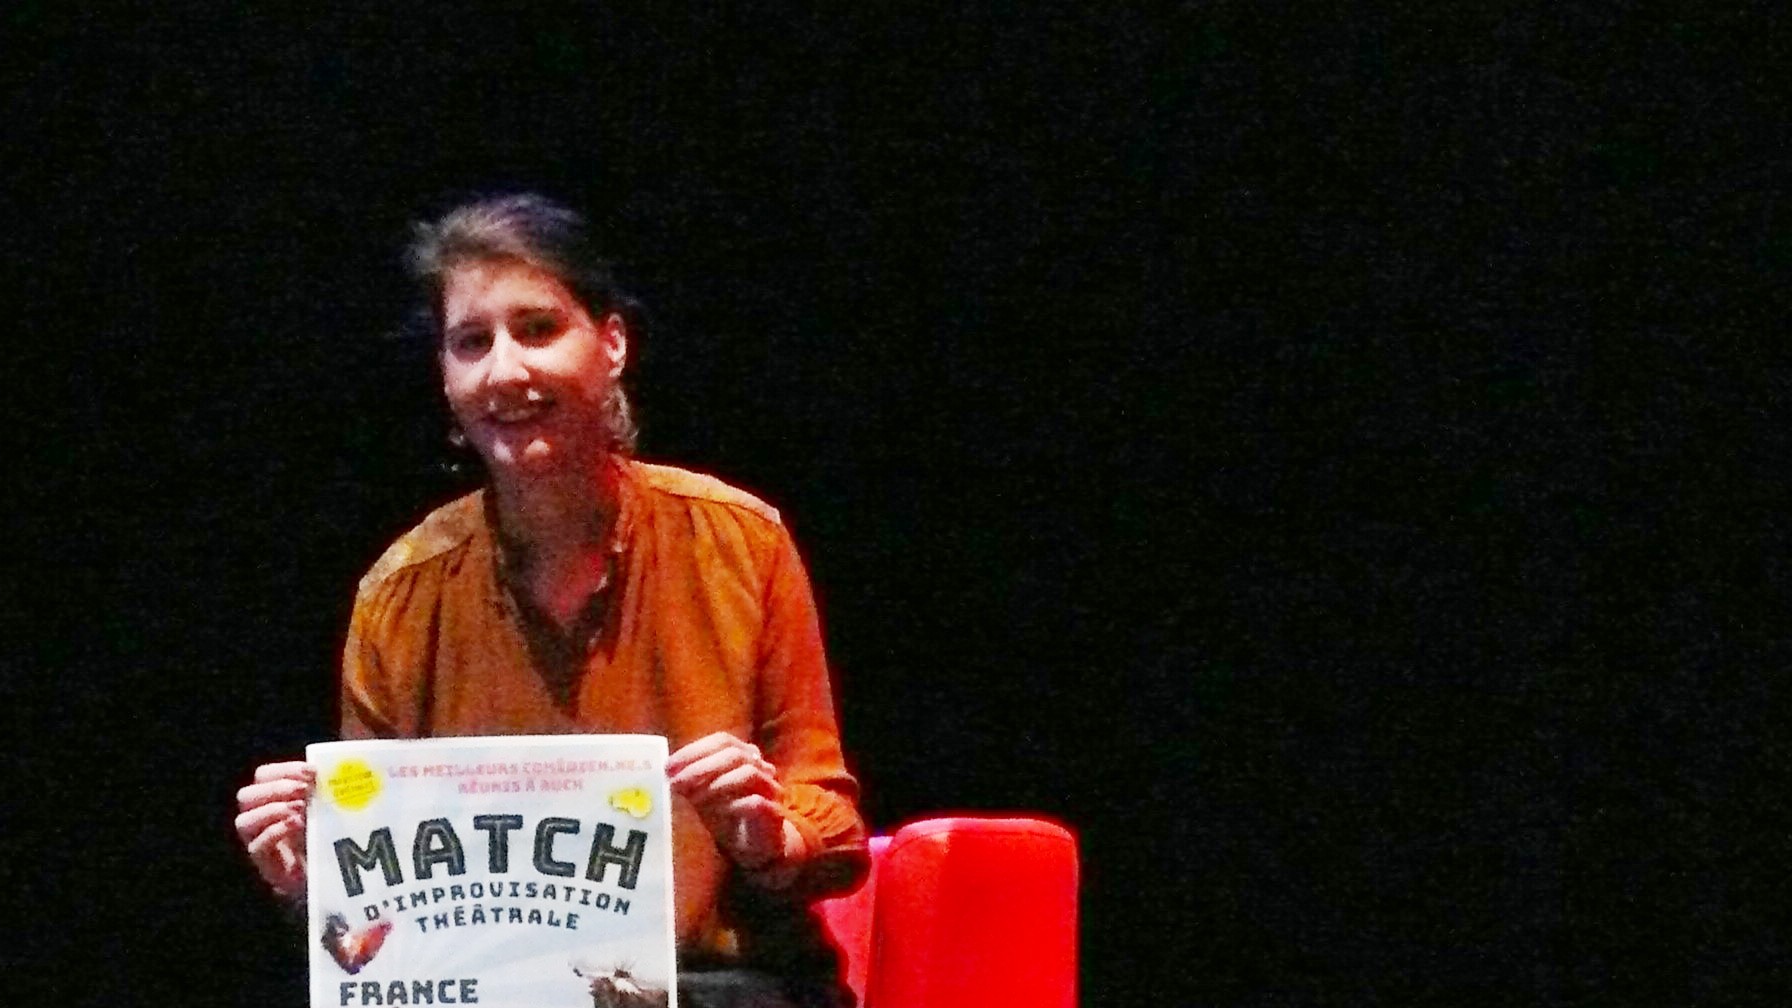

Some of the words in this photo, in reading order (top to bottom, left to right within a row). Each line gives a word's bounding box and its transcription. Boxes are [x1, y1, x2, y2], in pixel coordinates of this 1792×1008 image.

[333, 814, 648, 897] MATCH
[364, 880, 631, 922] D'IMPROVISATION
[415, 904, 580, 933] THÉÂTRALE
[340, 978, 479, 1006] FRANCE
